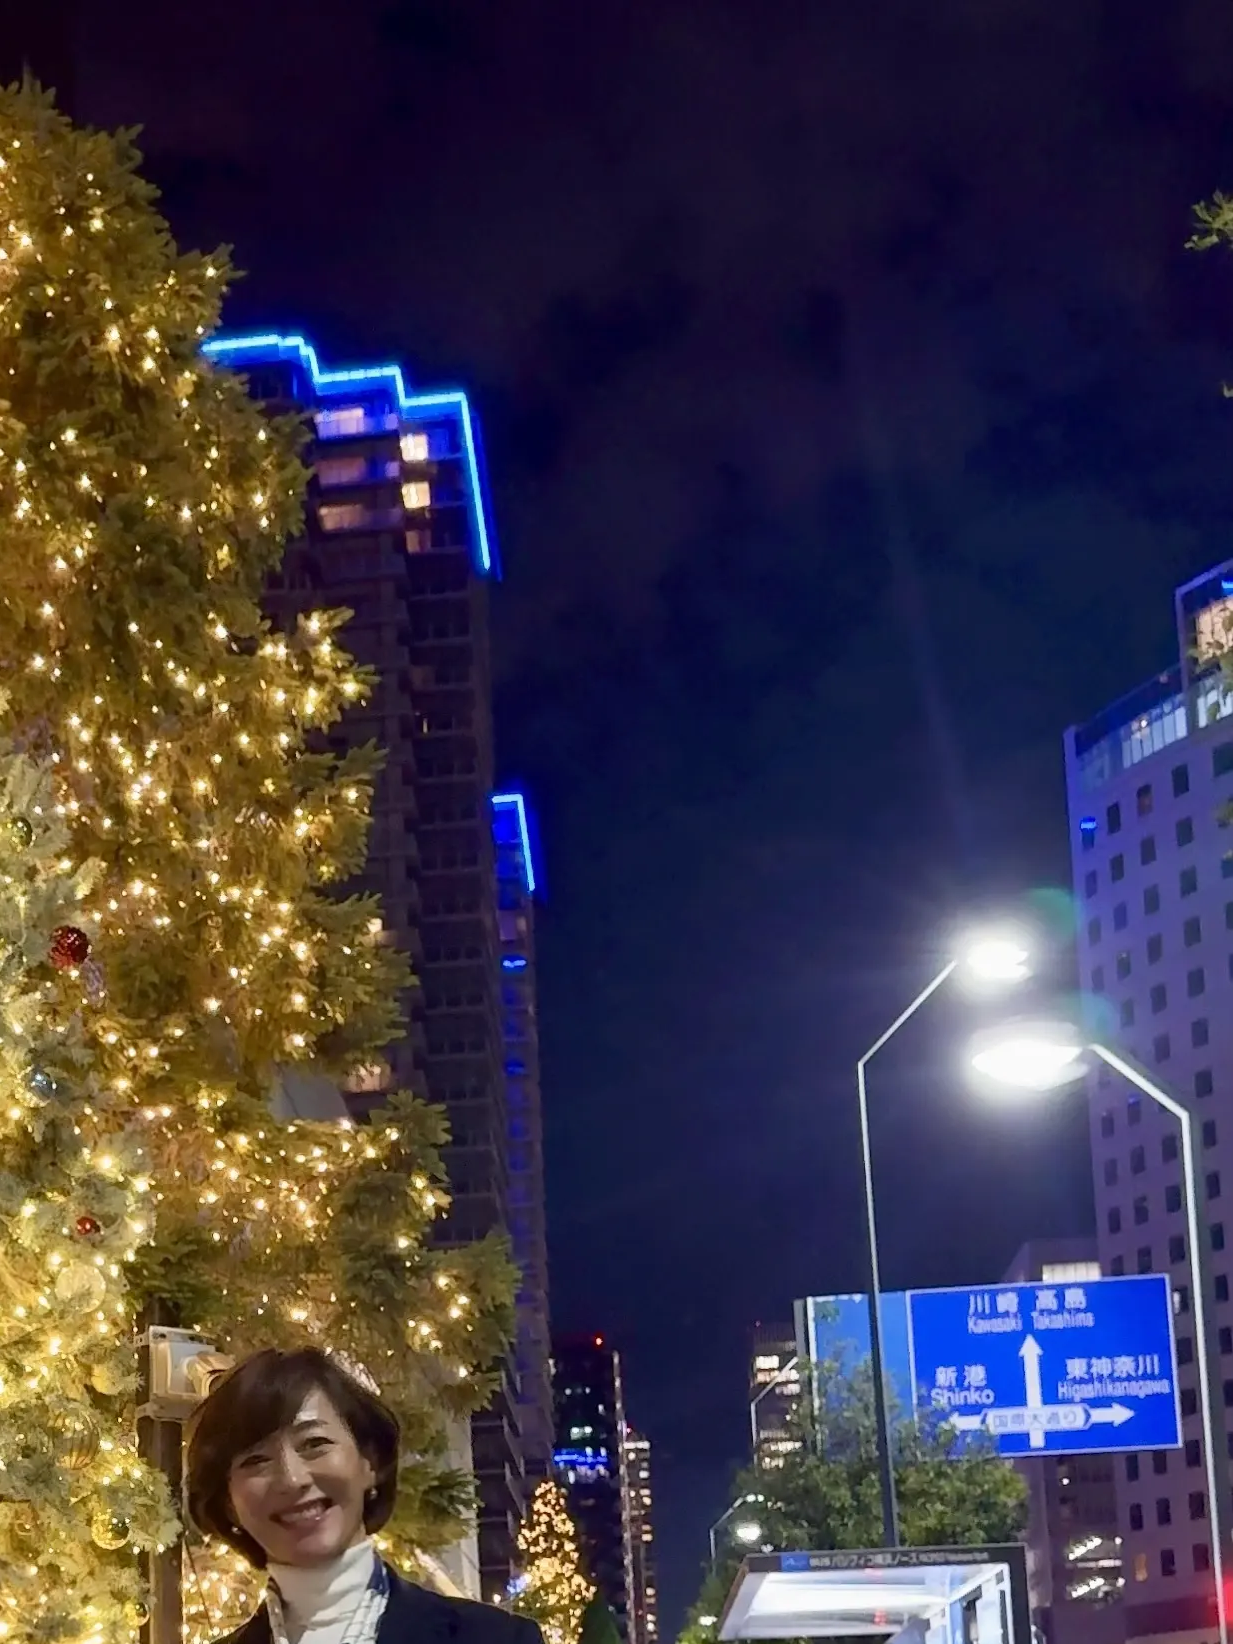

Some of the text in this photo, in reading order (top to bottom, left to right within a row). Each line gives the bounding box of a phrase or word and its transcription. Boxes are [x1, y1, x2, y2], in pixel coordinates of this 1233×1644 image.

[967, 1309, 1095, 1334] Kawasaki Takashima
[935, 1364, 988, 1388] 新港
[1065, 1354, 1160, 1381] 東神奈川
[930, 1387, 995, 1406] Shinko
[1057, 1378, 1171, 1403] Higashikanagawa
